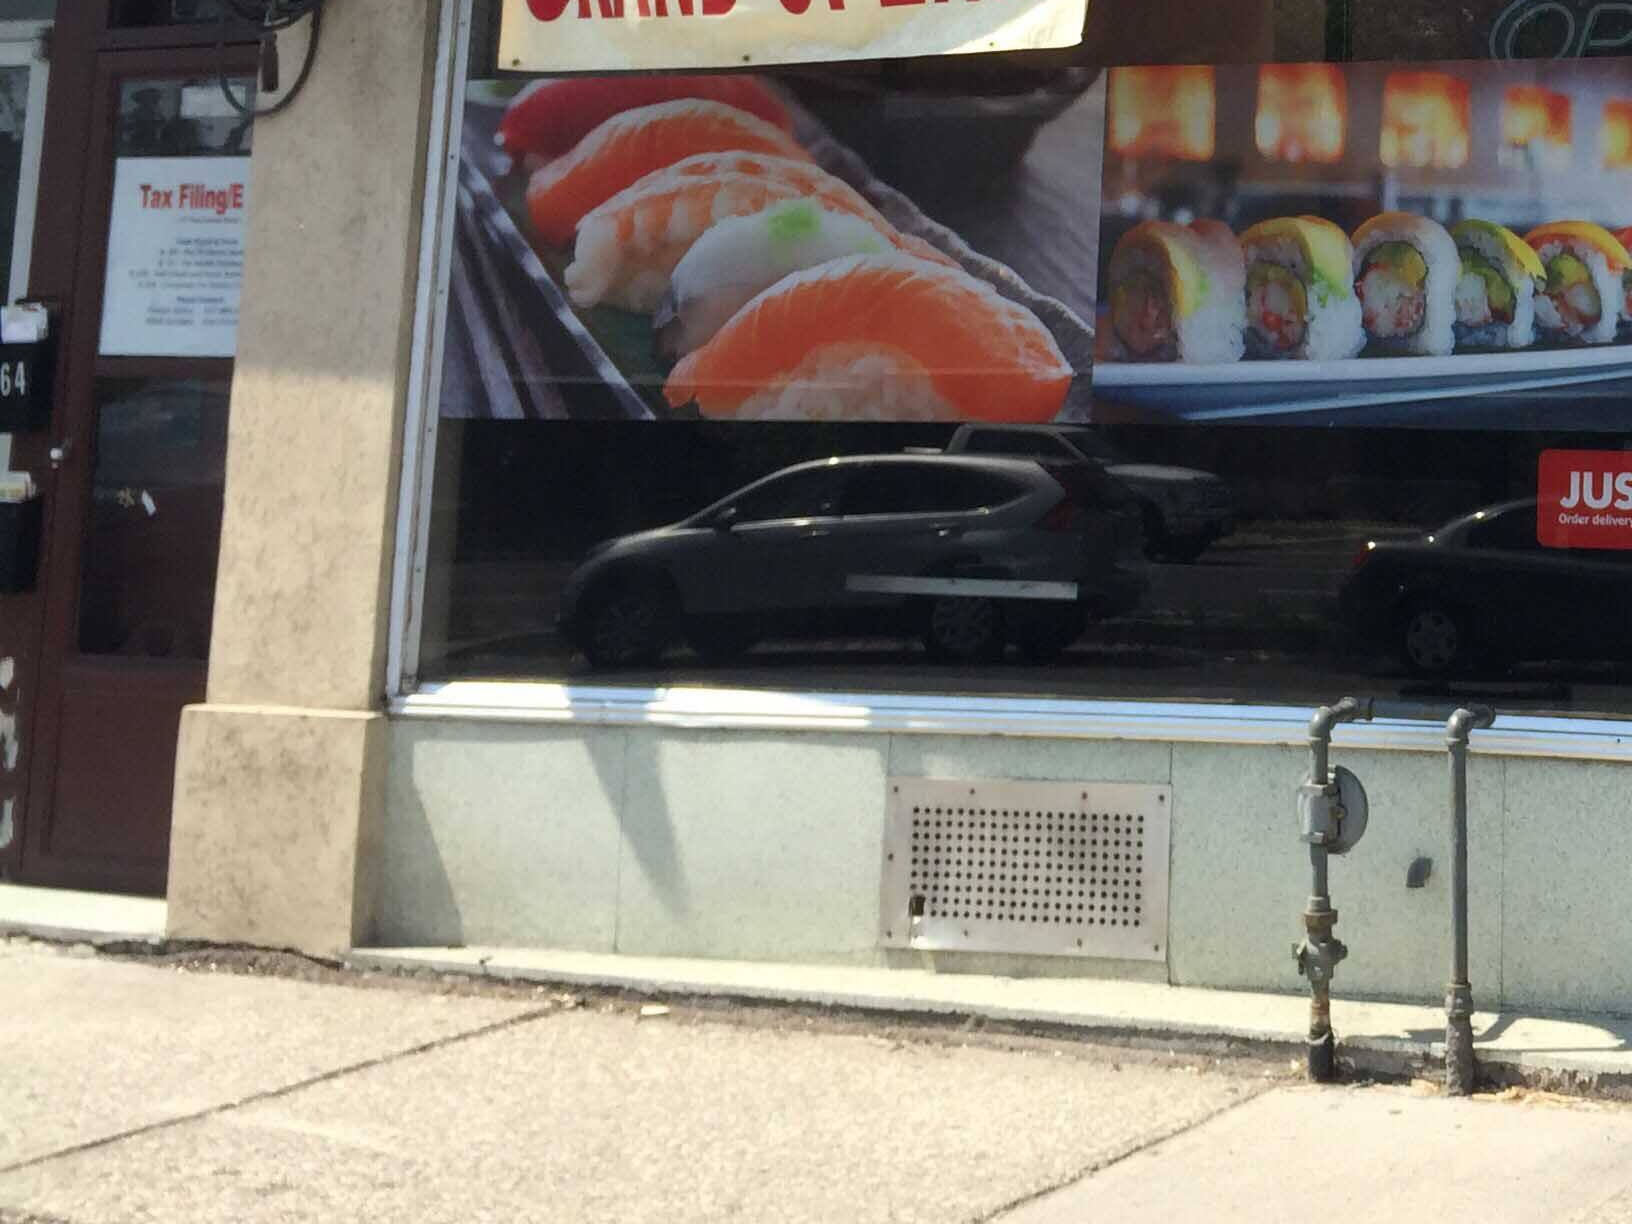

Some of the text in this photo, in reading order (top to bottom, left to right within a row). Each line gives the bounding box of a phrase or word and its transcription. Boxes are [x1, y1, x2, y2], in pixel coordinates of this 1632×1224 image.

[140, 184, 173, 209] Tax
[0, 360, 25, 396] 64
[1558, 513, 1590, 525] Order
